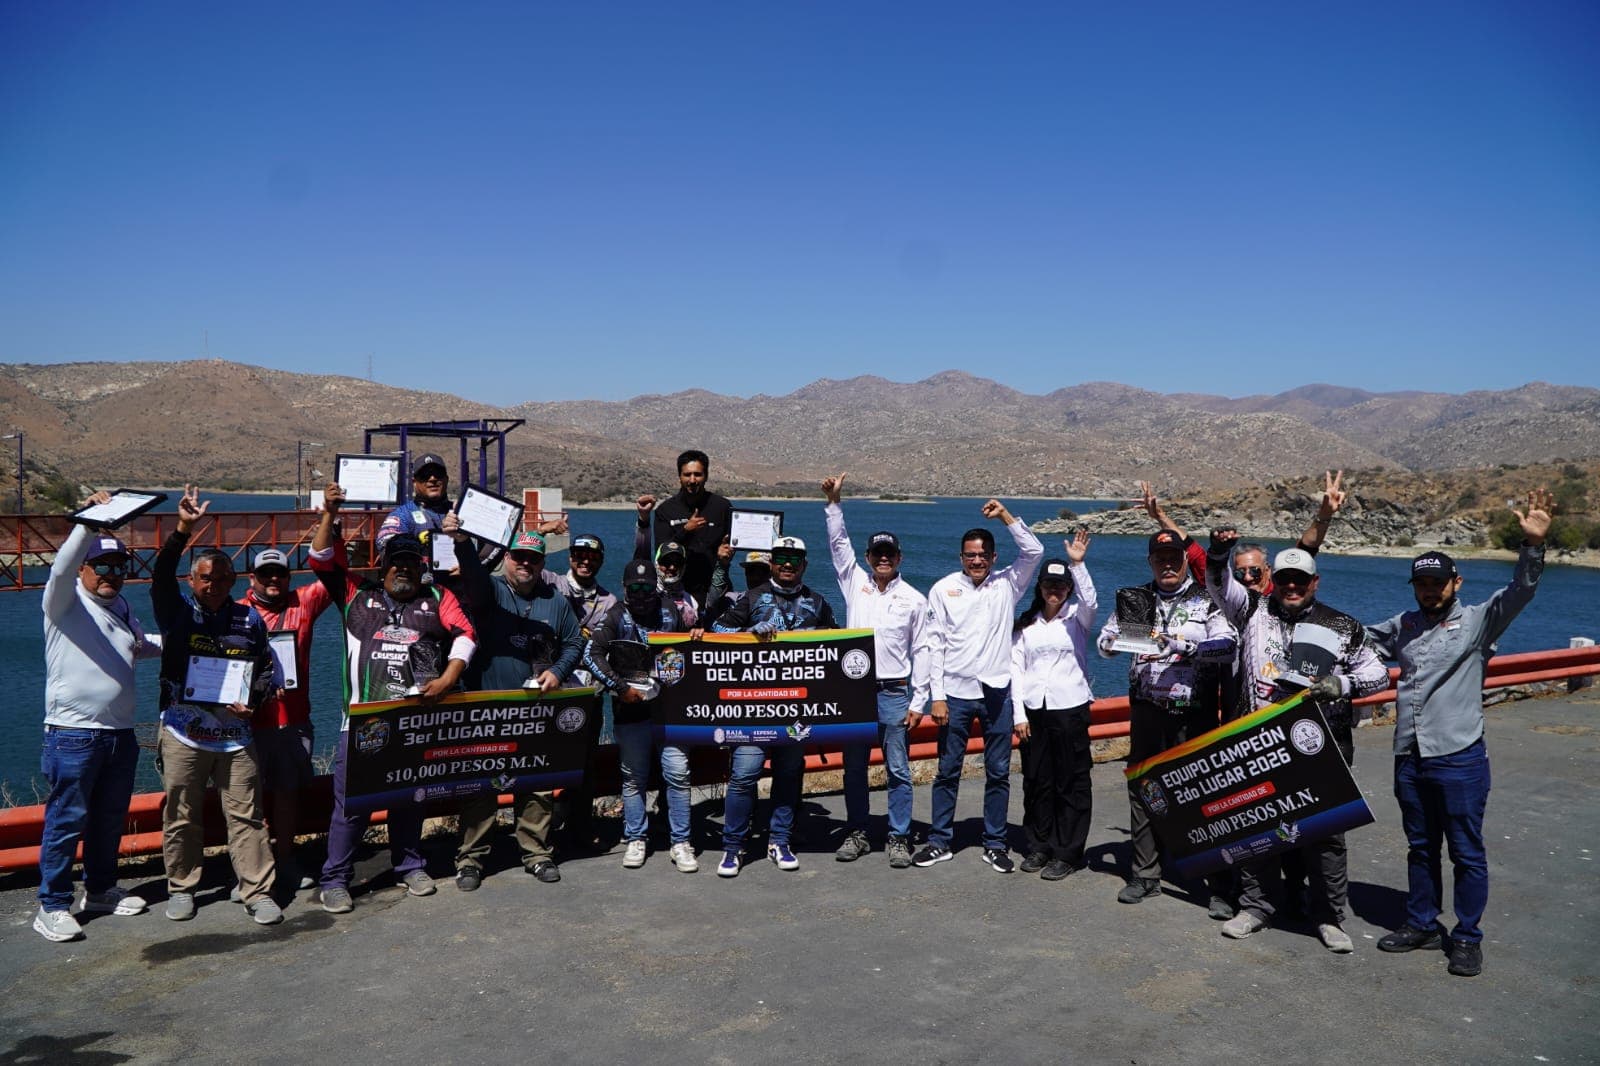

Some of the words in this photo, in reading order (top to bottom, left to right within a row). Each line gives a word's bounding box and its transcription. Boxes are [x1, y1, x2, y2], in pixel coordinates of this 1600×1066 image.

[1414, 558, 1441, 568] PESCA
[691, 650, 753, 667] EQUIPO
[758, 644, 838, 664] CAMPEÓN
[706, 668, 738, 682] DEL
[741, 664, 777, 682] AÑO
[781, 665, 825, 680] 2026
[727, 690, 742, 698] POR
[743, 690, 752, 698] LA
[753, 689, 788, 697] CANTIDAD
[789, 689, 799, 697] DE
[398, 709, 465, 731] EQUIPO
[470, 702, 555, 723] CAMPEÓN
[686, 703, 742, 721] $30,000
[744, 702, 799, 719] PESOS
[802, 701, 842, 718] M.N.
[403, 731, 433, 746] 3er
[437, 724, 495, 741] LUGAR
[500, 721, 546, 737] 2026
[432, 750, 449, 758] POR
[461, 745, 498, 754] CANTIDAD
[1161, 758, 1211, 788] EQUIPO
[1209, 725, 1287, 769] CAMPEÓN
[385, 762, 447, 784] $10,000
[449, 757, 506, 775] PESOS
[510, 754, 550, 770] M.N.
[1174, 785, 1201, 805] 2do
[1199, 765, 1247, 795] LUGAR
[1246, 747, 1292, 777] 2026
[1220, 801, 1230, 810] LA
[1229, 790, 1258, 807] CANTIDAD
[1187, 818, 1232, 845] $20,000
[1229, 801, 1278, 831] PESOS
[1275, 787, 1321, 814] M.N.
